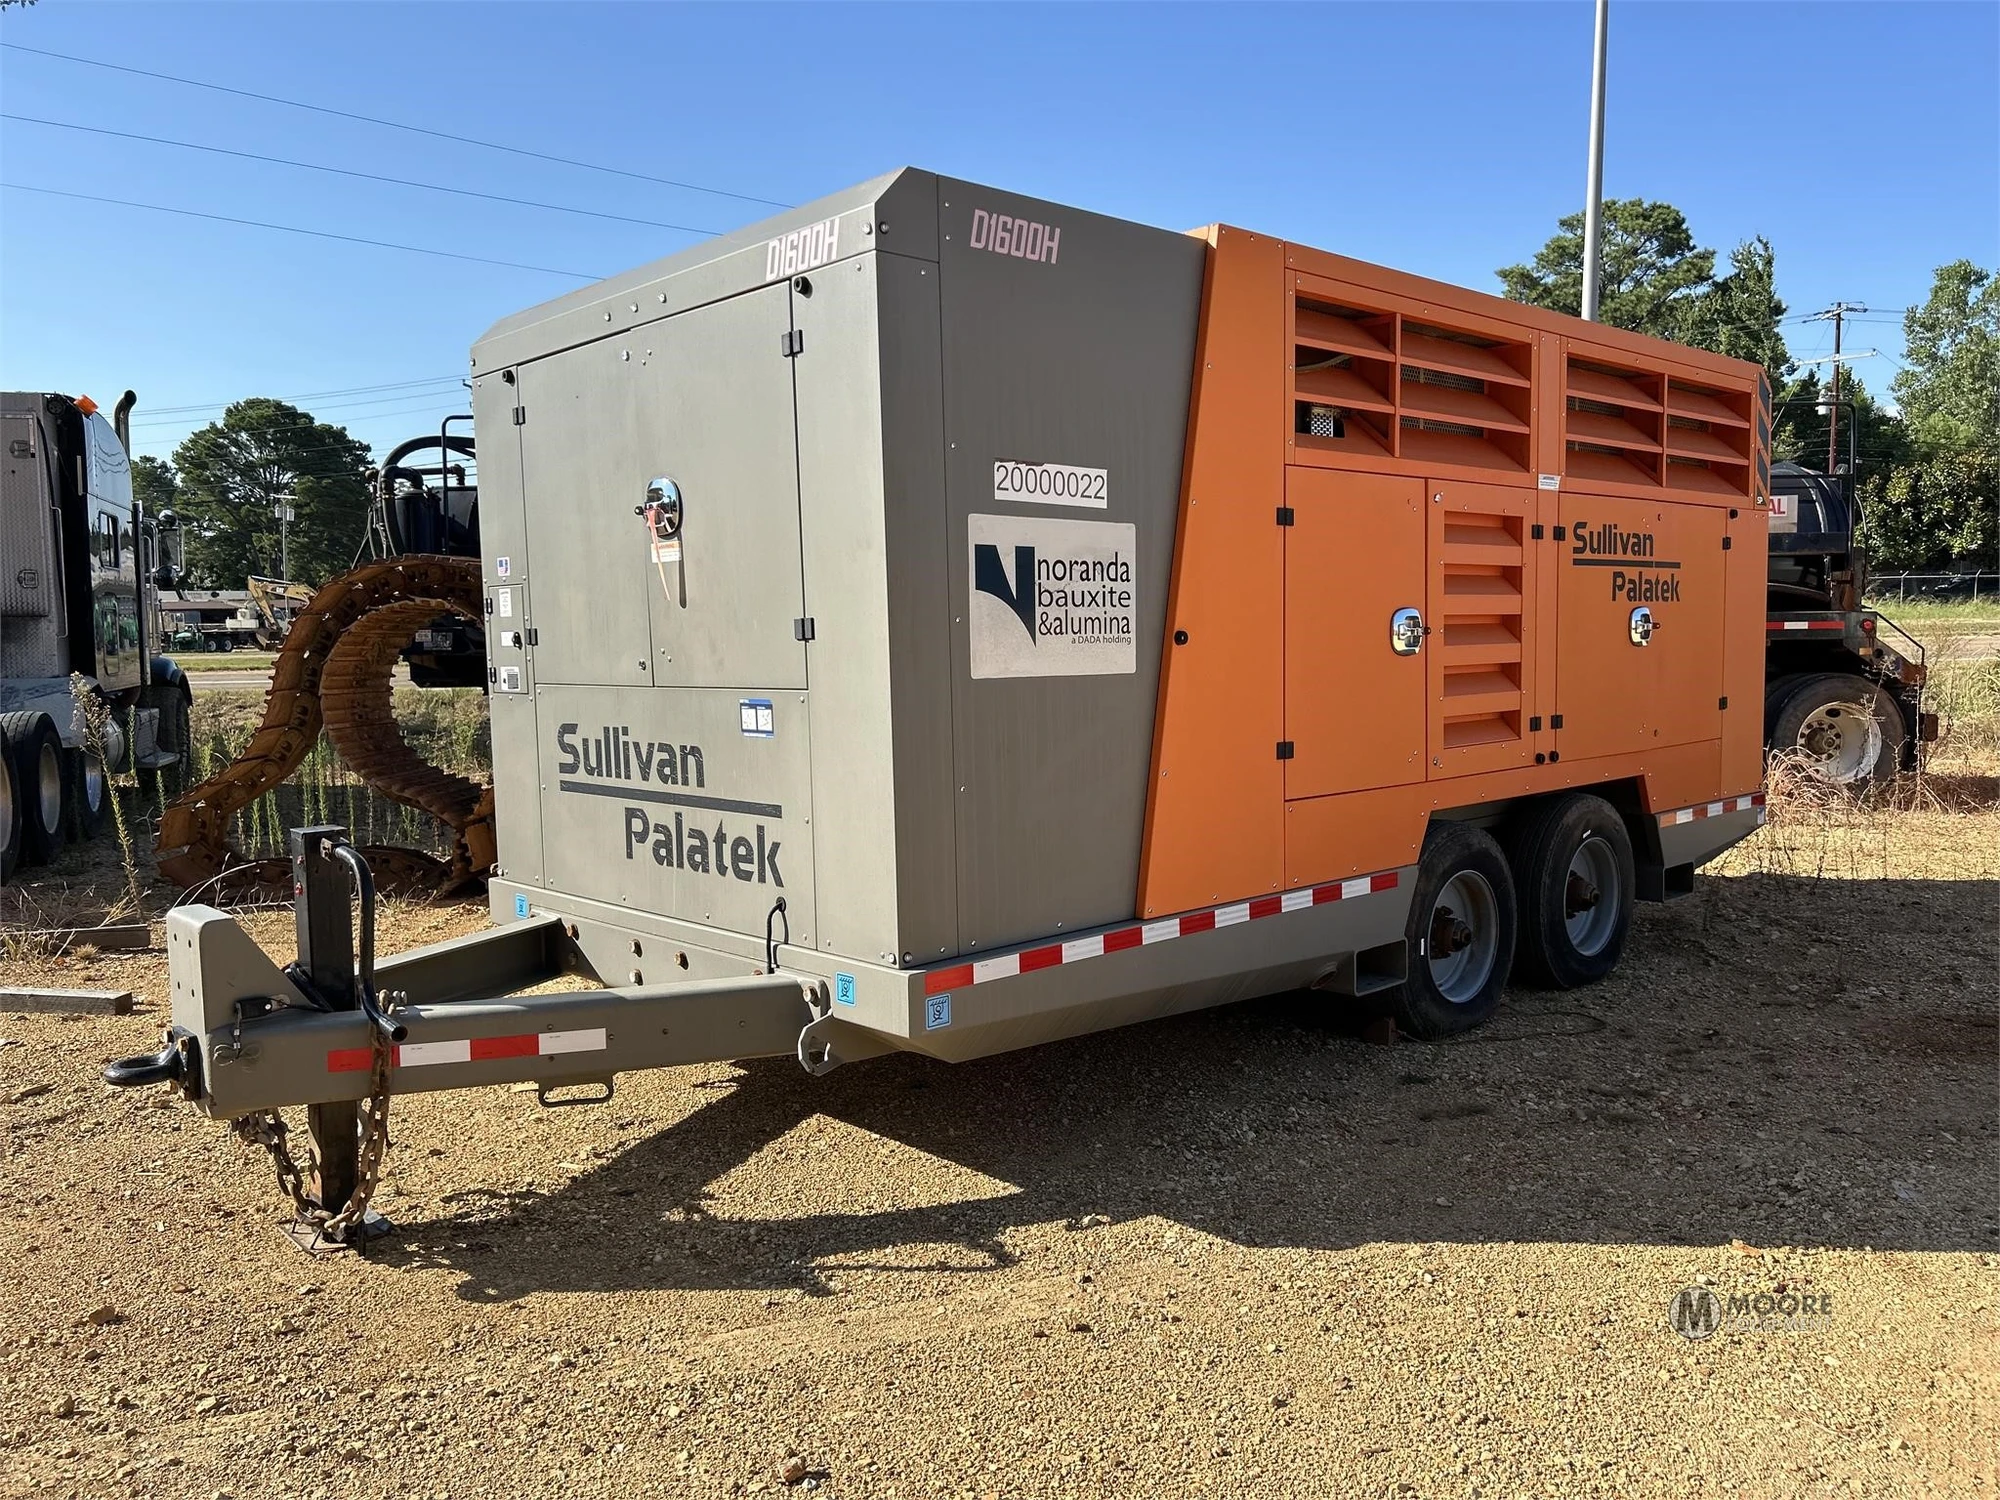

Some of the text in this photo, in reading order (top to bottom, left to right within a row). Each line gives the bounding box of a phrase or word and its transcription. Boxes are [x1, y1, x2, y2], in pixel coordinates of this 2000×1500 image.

[765, 217, 840, 281] D1600H
[970, 208, 1060, 264] D1600H
[996, 464, 1105, 500] 20000022
[1572, 521, 1653, 557] Sullivan
[1037, 551, 1131, 583] noranda
[1037, 582, 1131, 608] bauxite
[1611, 571, 1681, 602] Palatek
[1038, 609, 1131, 636] &alumina
[1077, 635, 1101, 645] DADA
[1102, 635, 1132, 646] holding
[556, 722, 705, 788] Sullivan
[624, 806, 784, 888] Palatek
